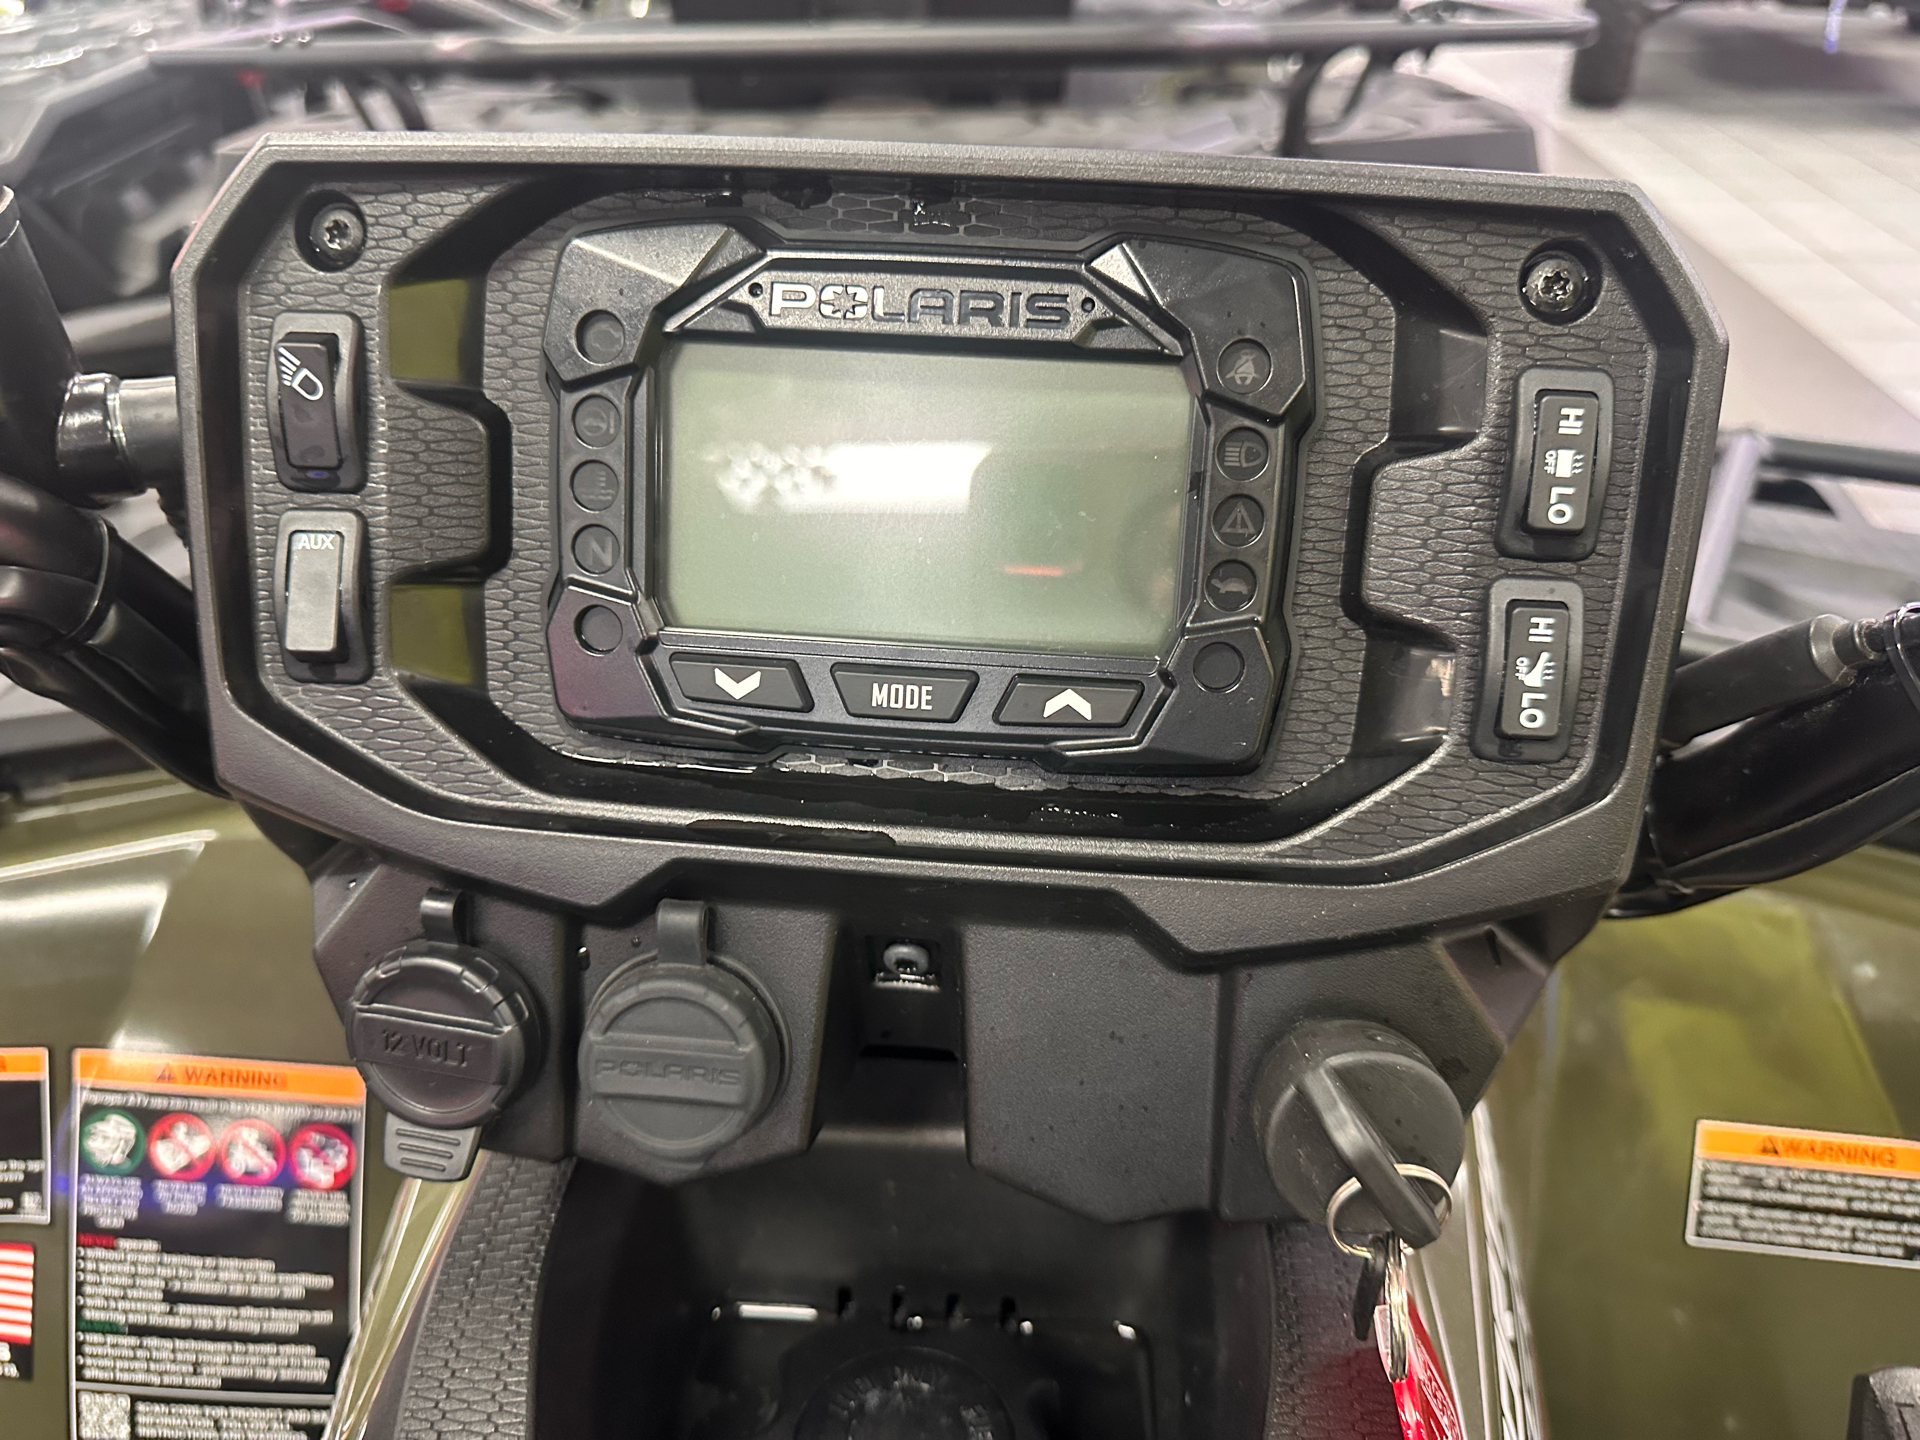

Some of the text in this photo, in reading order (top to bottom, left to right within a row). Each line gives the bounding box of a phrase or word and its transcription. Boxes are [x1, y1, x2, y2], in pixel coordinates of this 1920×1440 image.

[769, 281, 1072, 329] POLARIS
[1558, 407, 1585, 435] HI
[1544, 450, 1557, 475] OFF
[1547, 486, 1576, 525] LO
[298, 534, 335, 550] AUX
[1528, 616, 1556, 643] HI
[1514, 656, 1529, 681] OFF
[871, 682, 933, 710] MODE
[1519, 692, 1547, 729] LO
[382, 1029, 472, 1067] 12 VOLT
[184, 1065, 287, 1092] WARNING
[594, 1059, 741, 1086] POLARIS
[1780, 1139, 1897, 1168] WARNING
